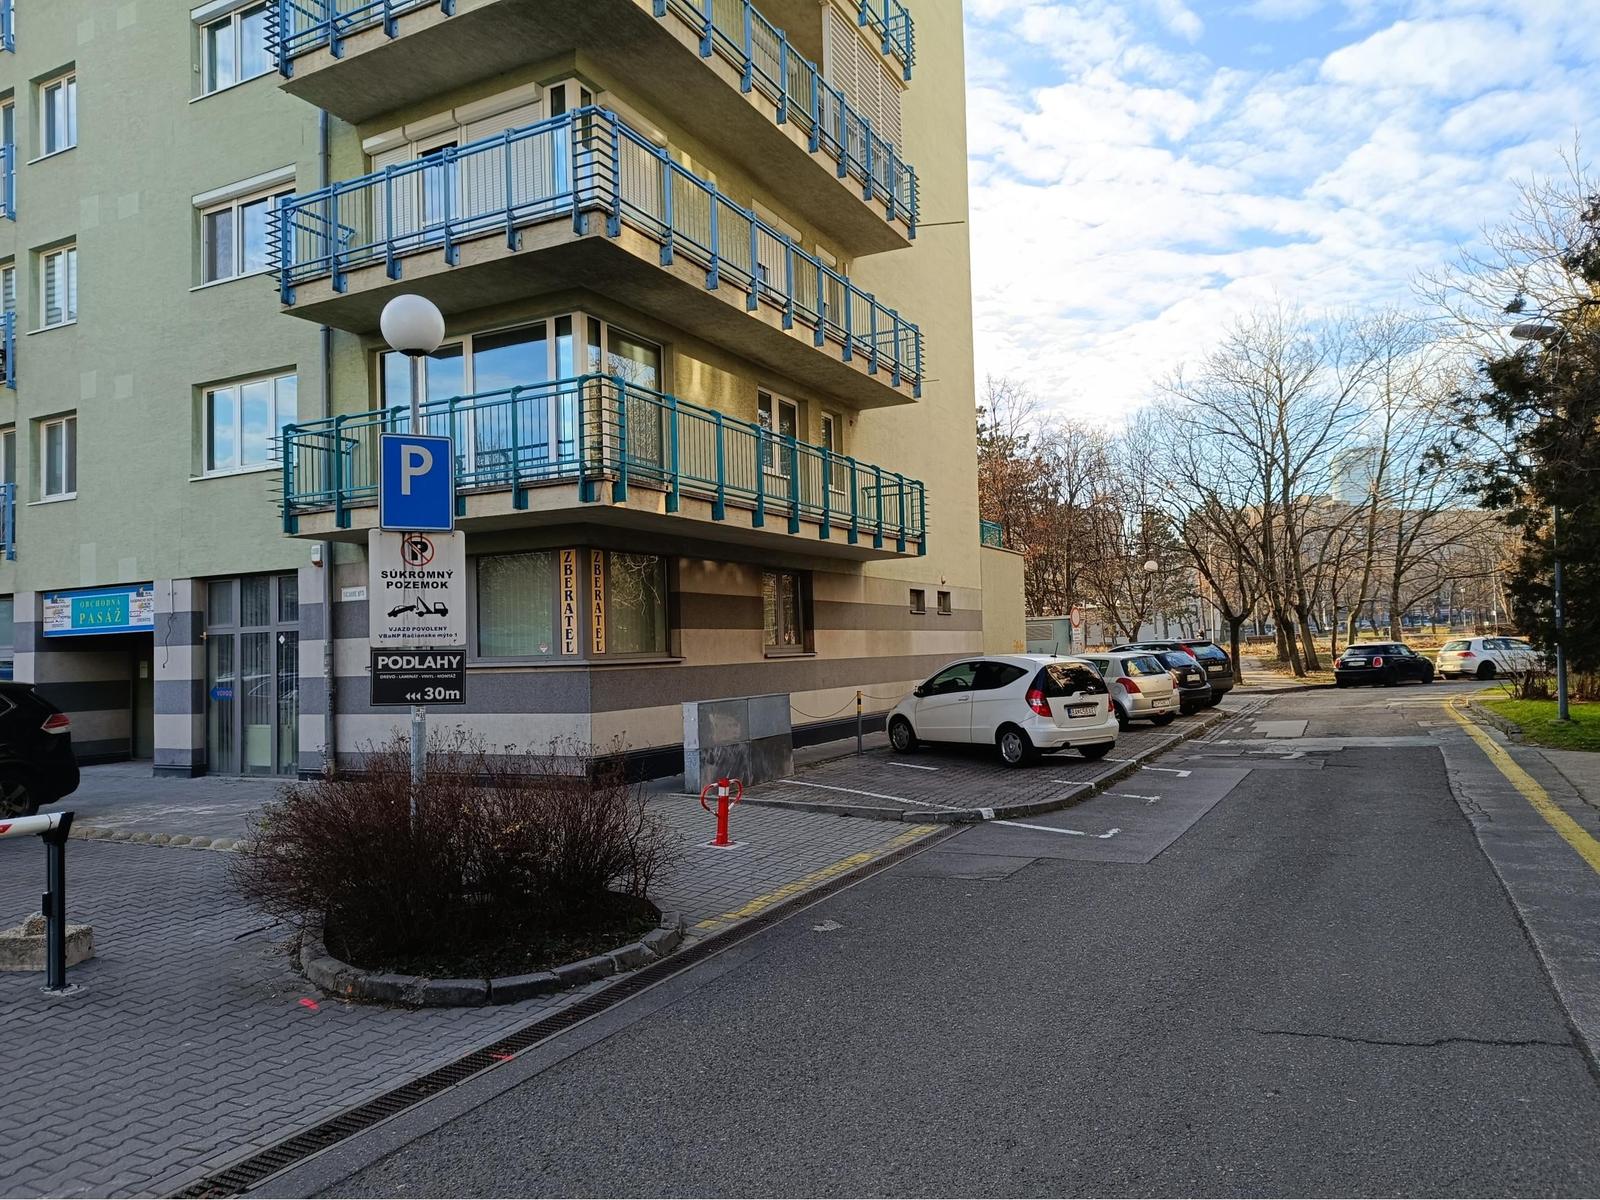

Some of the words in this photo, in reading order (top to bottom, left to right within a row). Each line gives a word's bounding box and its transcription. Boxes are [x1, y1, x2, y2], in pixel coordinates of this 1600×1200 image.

[401, 444, 433, 495] P
[381, 569, 453, 579] SÚKROMNÝ
[386, 581, 448, 589] POZEMOK
[79, 608, 122, 624] PASÁŽ
[377, 655, 461, 669] PODLAHY
[424, 686, 460, 700] 30m
